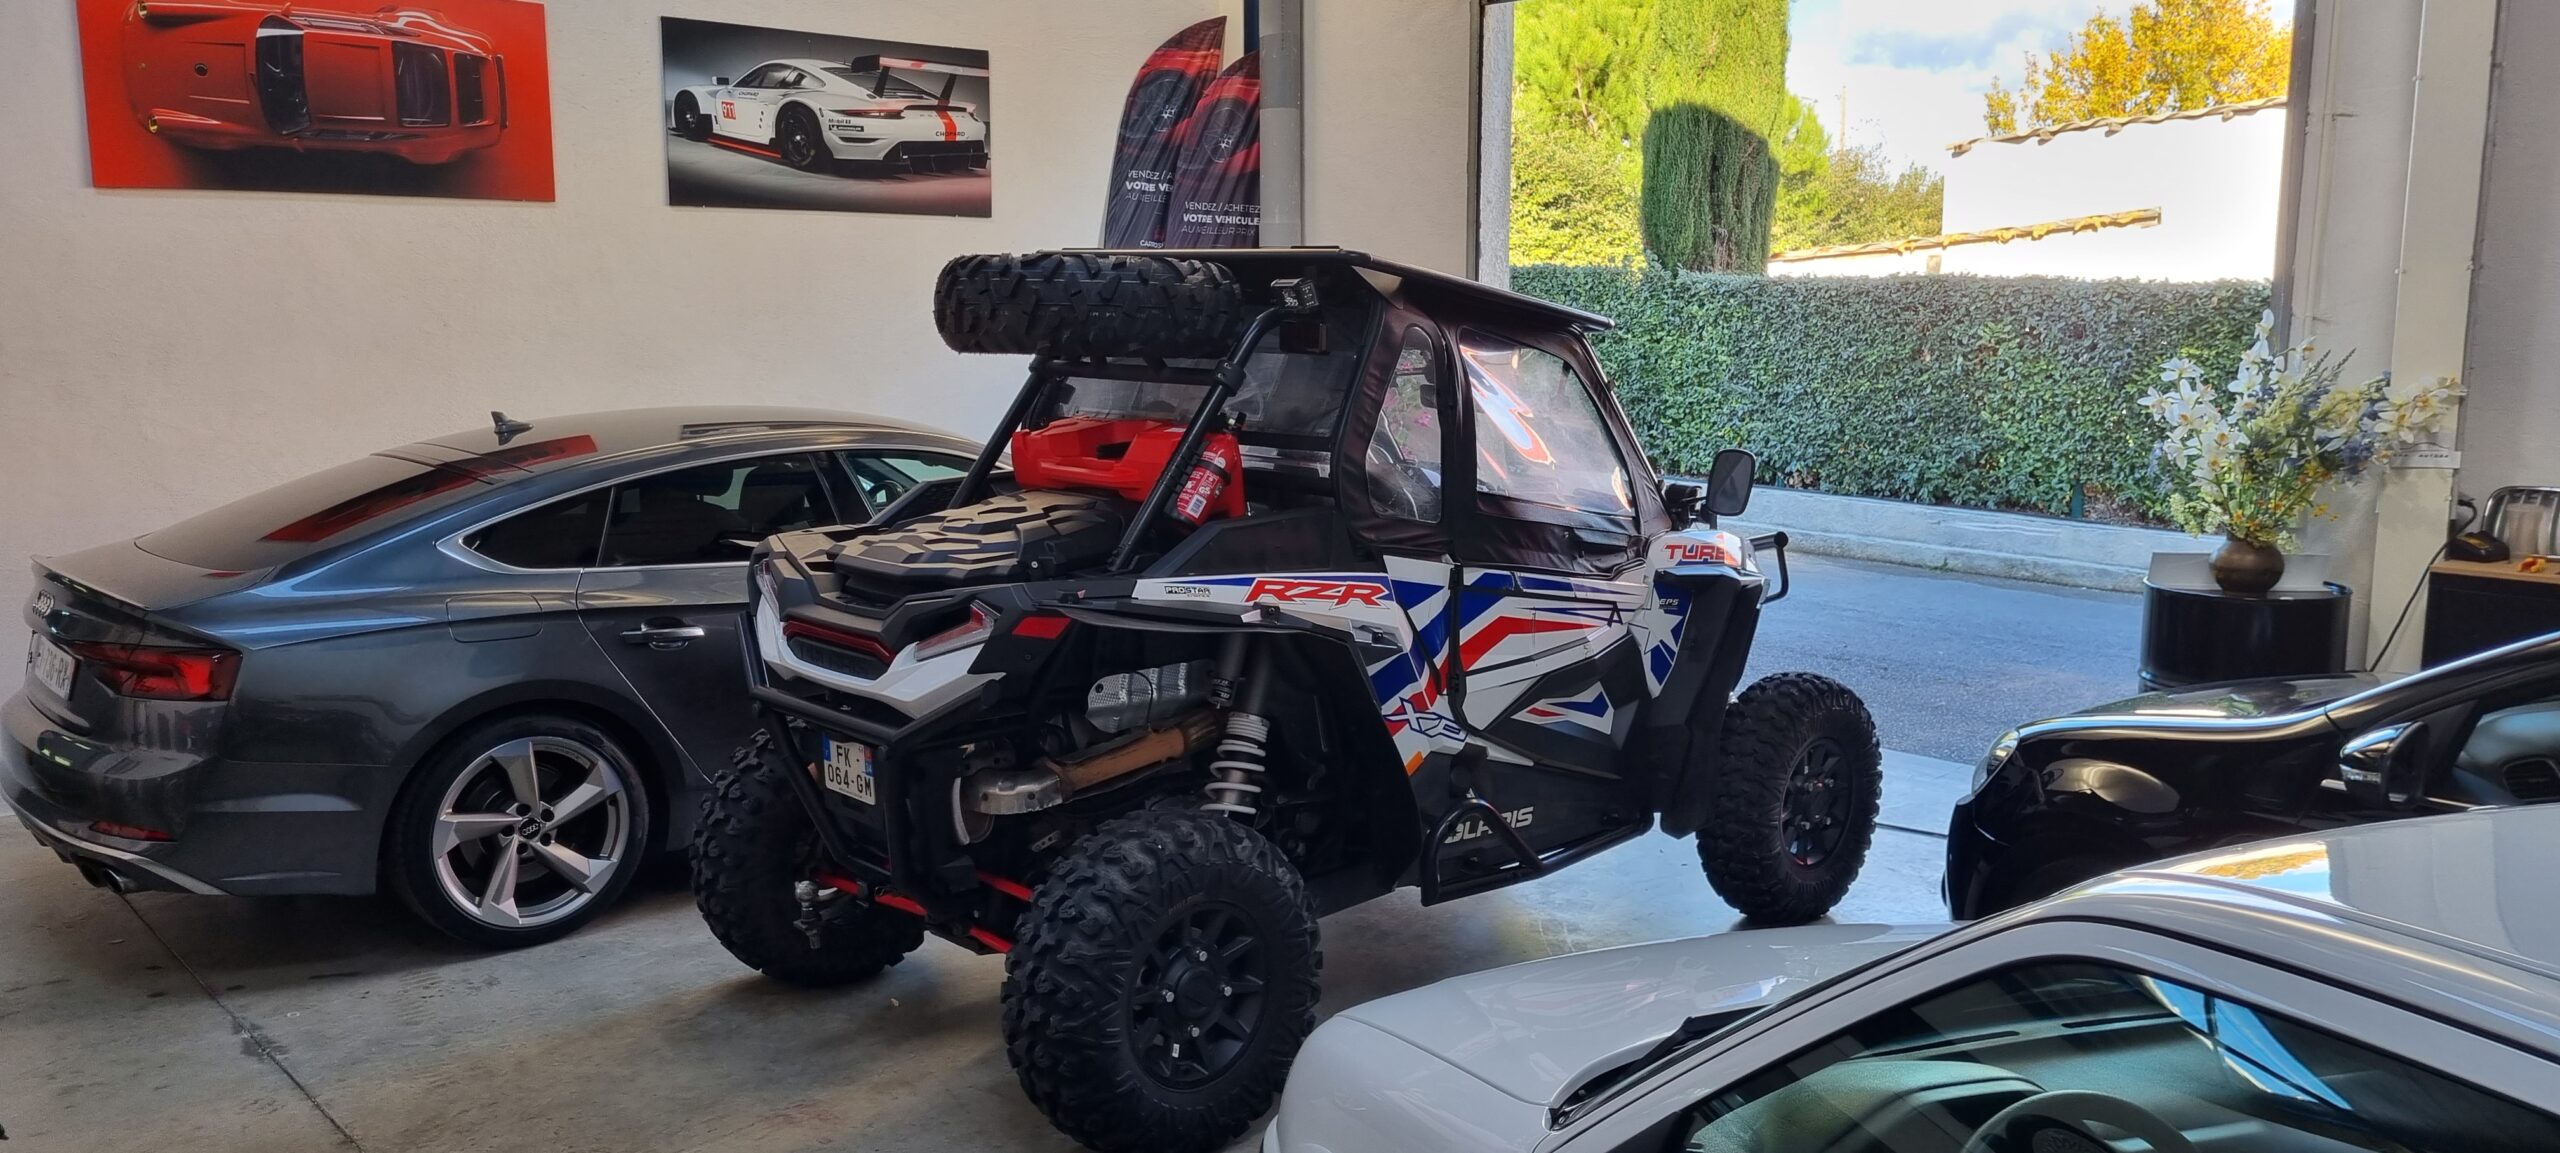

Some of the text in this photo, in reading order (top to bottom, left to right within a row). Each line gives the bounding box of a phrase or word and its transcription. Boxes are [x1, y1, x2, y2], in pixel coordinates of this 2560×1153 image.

[722, 103, 736, 119] 911
[1128, 169, 1160, 180] VENDEZ
[1125, 181, 1156, 192] VOTRE
[1185, 201, 1217, 212] VENDEZ
[1183, 213, 1212, 224] VOTRE
[1181, 225, 1195, 233] AU
[1164, 585, 1212, 595] PROSTAR
[1244, 577, 1388, 608] RZR
[1659, 598, 1680, 606] EPS
[827, 763, 873, 798] 064-GM
